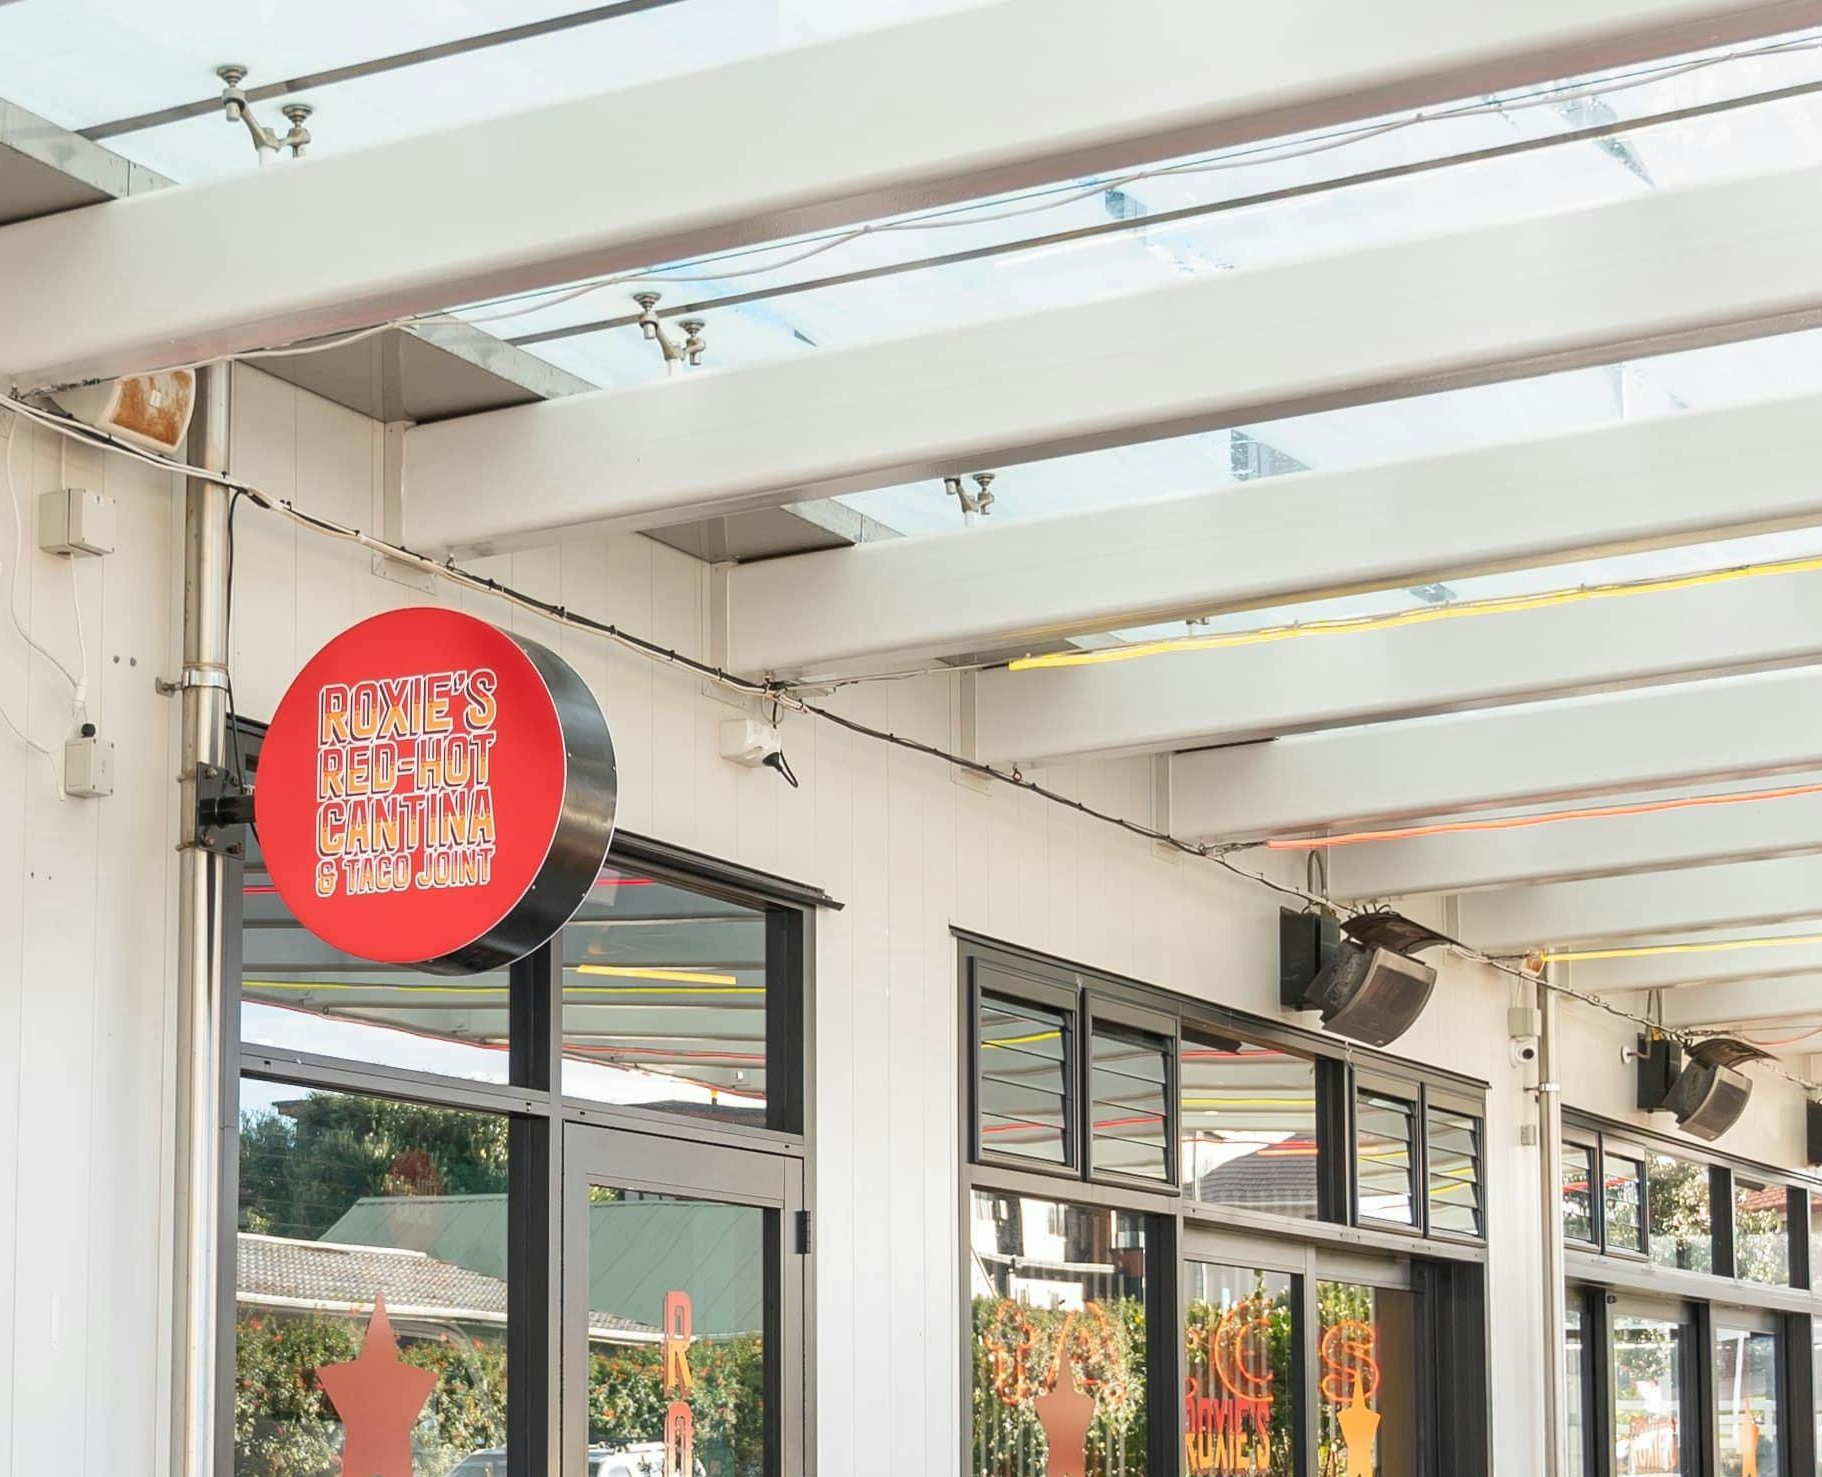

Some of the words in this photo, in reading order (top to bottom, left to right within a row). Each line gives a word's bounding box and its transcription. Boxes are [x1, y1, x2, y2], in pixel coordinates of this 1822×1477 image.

[318, 668, 498, 747] ROXIE'S
[317, 733, 497, 801] RED-HOT
[316, 785, 496, 858] CANTINA
[316, 858, 338, 897] &
[345, 852, 412, 894] TACO
[417, 846, 495, 888] JOINT
